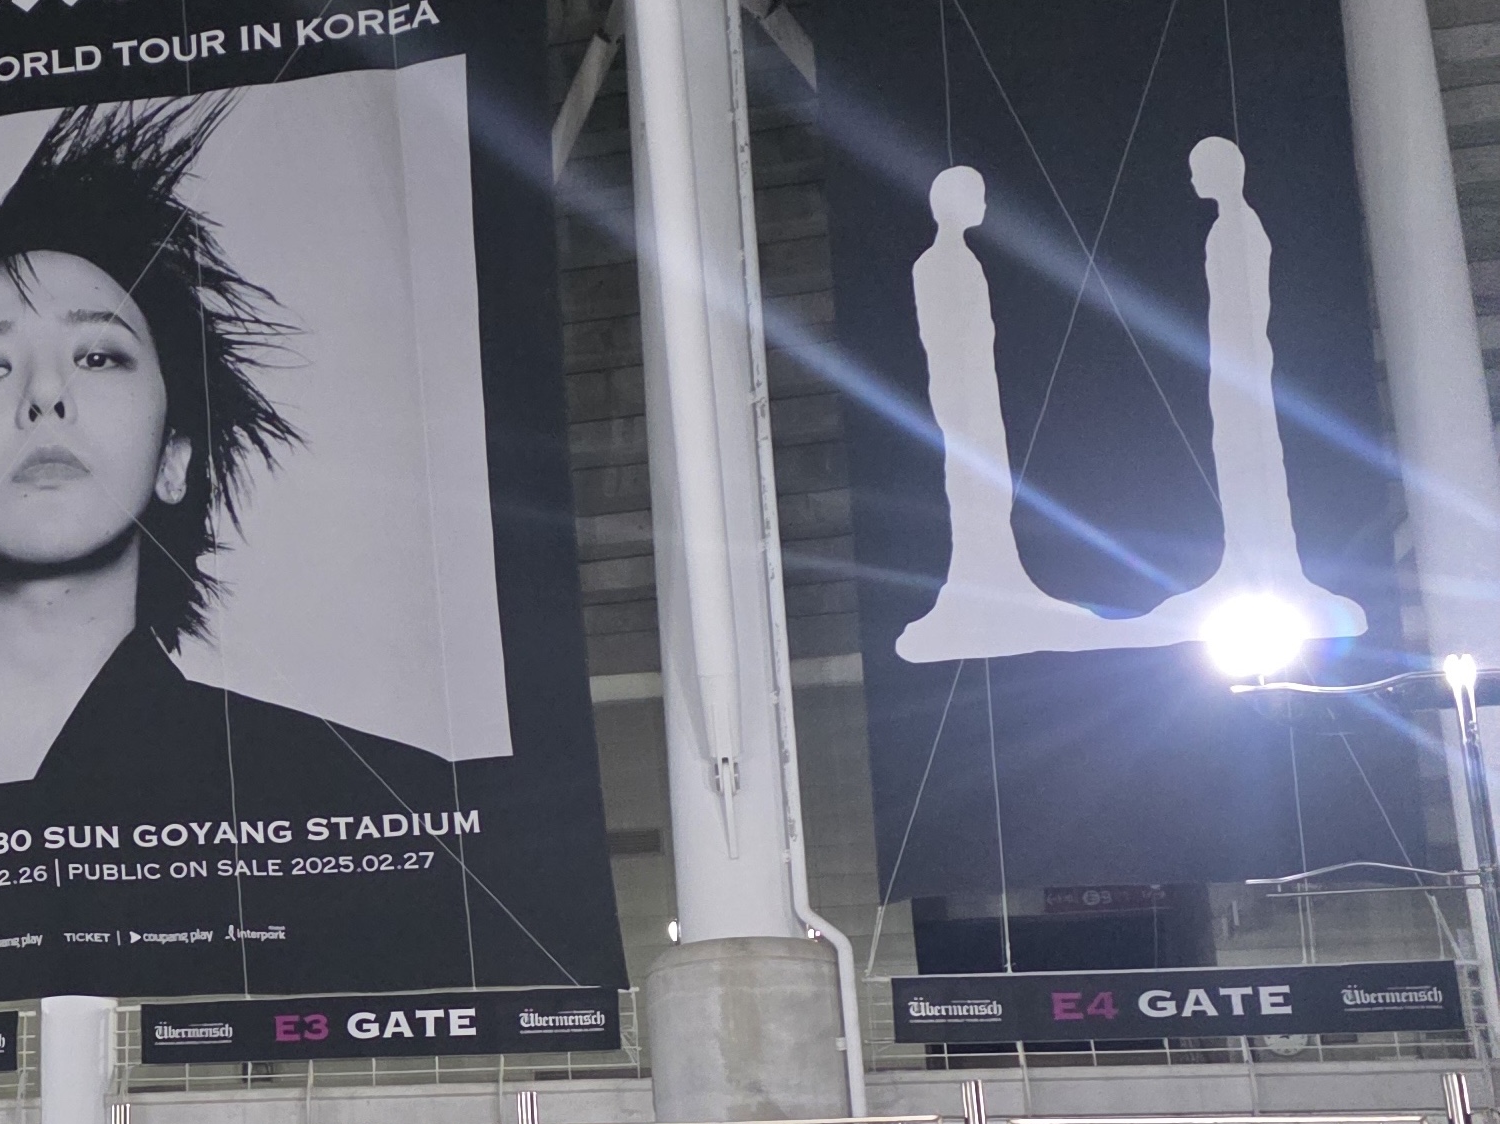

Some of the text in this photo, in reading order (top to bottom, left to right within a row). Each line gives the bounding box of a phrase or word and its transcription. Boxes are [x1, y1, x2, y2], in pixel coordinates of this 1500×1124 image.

[112, 28, 226, 66] TOUR
[240, 22, 282, 51] IN
[297, 0, 440, 46] KOREA
[43, 824, 120, 850] SUN
[132, 820, 293, 848] GOYANG
[305, 809, 481, 841] STADIUM
[68, 862, 161, 881] PUBLIC
[169, 860, 208, 879] ON
[217, 859, 284, 877] SALE
[291, 851, 435, 875] 2025.02.27
[21, 933, 43, 948] play
[64, 932, 111, 942] TICKET
[190, 928, 213, 943] play
[909, 984, 1443, 1021] Übermensch E4 GATE Übermensch
[154, 1008, 606, 1042] Übermensch E3 GATE Übermensch
